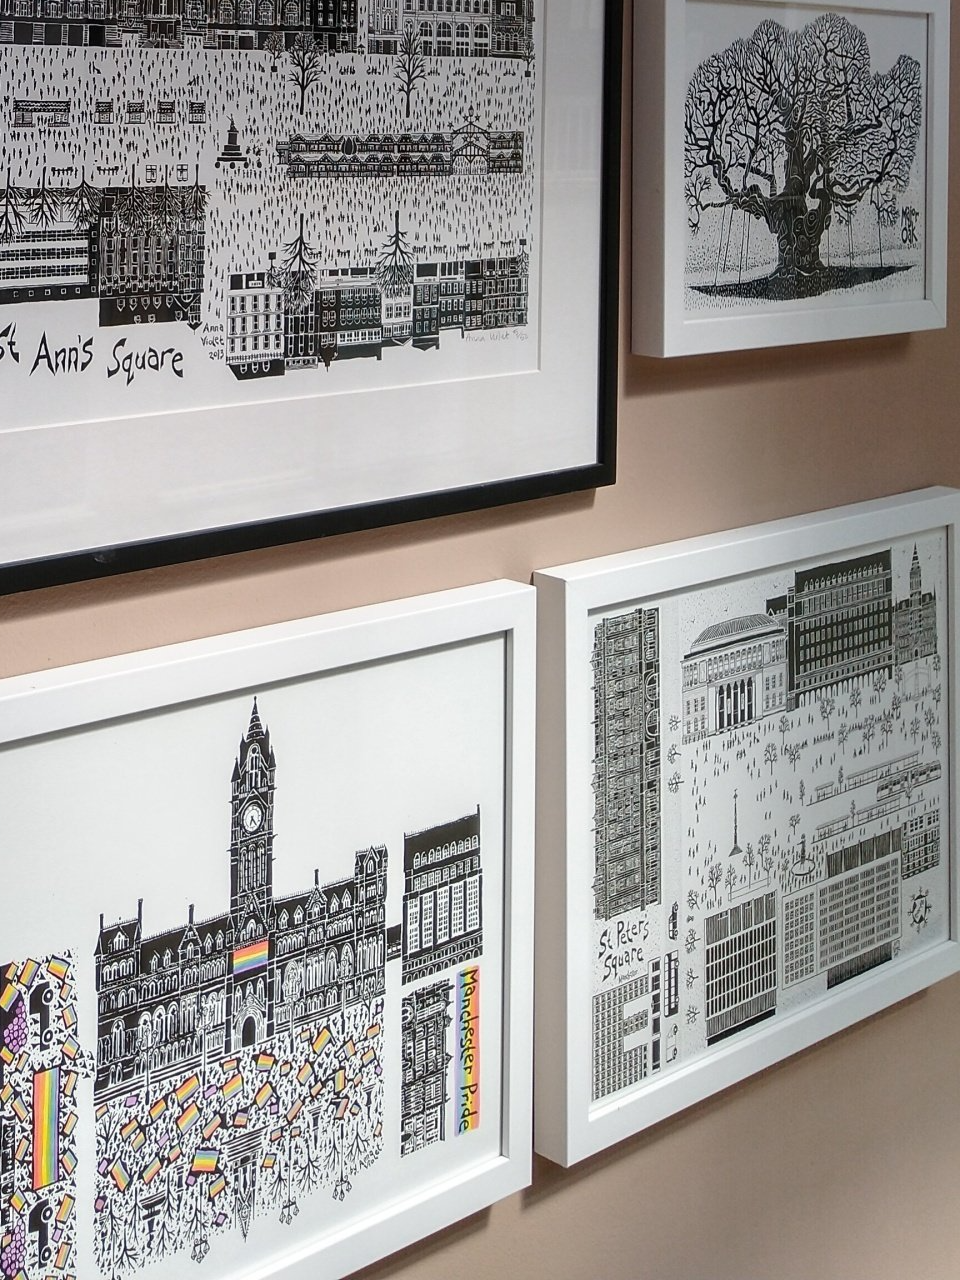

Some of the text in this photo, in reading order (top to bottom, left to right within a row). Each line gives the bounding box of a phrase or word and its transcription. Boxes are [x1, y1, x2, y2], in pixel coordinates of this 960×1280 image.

[901, 222, 918, 244] Oak
[200, 335, 225, 347] Violet
[203, 323, 224, 333] Anna
[29, 330, 94, 376] Ann's
[107, 337, 184, 386] Square
[209, 349, 225, 360] 2013
[598, 928, 614, 960] St
[601, 947, 645, 983] Square
[459, 967, 480, 1134] Manchester Pride
